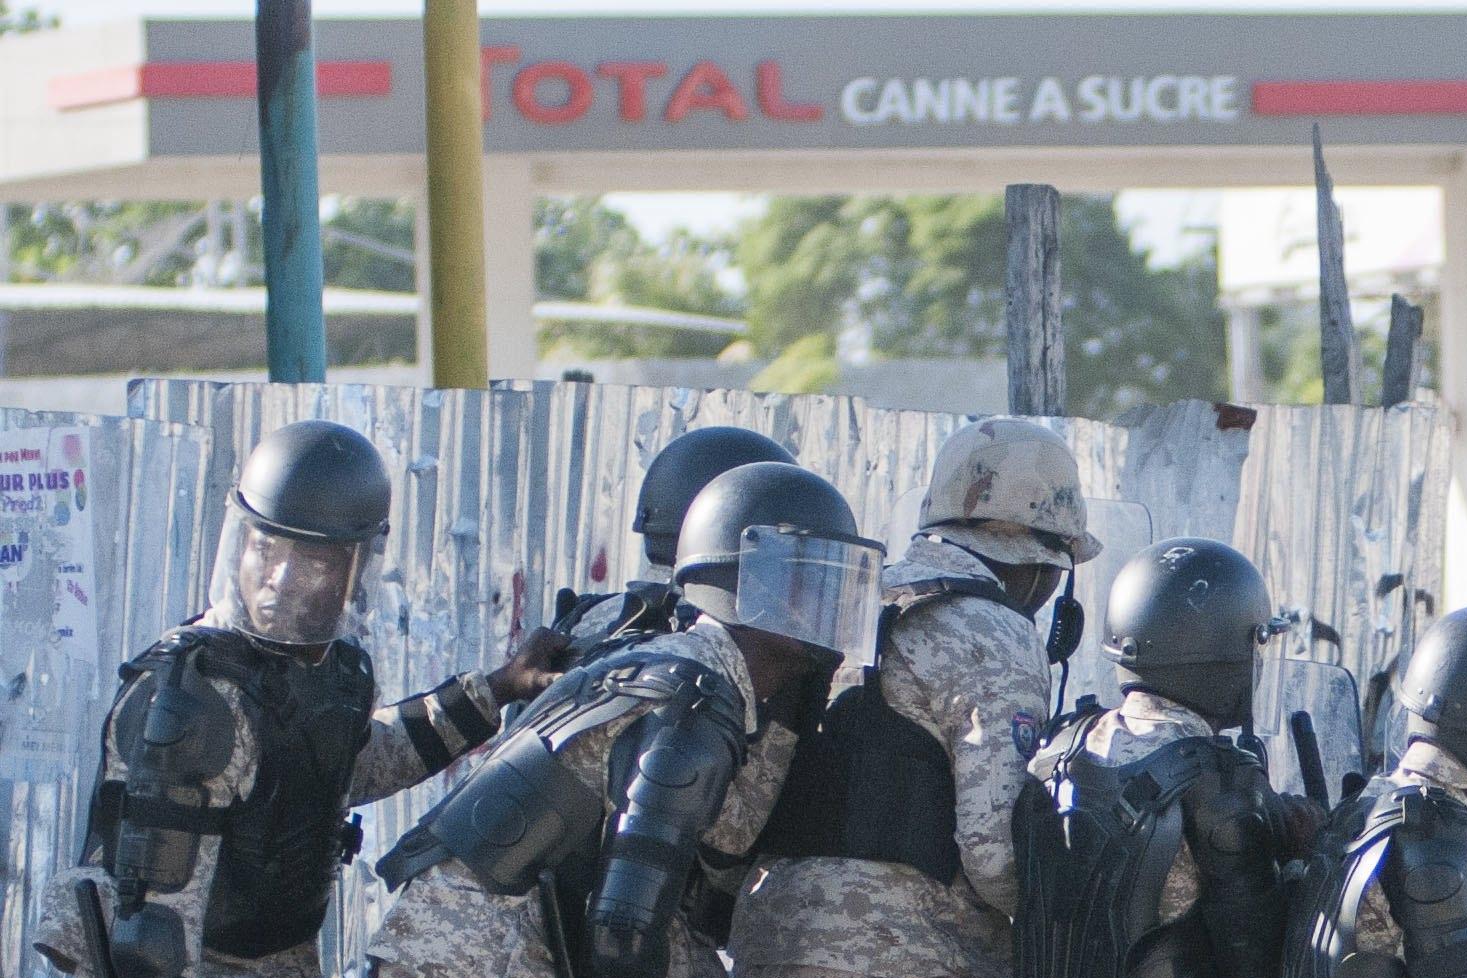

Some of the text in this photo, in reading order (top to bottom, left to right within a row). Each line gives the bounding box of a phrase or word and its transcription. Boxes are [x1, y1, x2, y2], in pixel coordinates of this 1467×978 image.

[841, 77, 1021, 124] CANNE
[1029, 77, 1071, 122] A
[1077, 75, 1239, 122] SUCRE
[28, 471, 70, 491] PLUS
